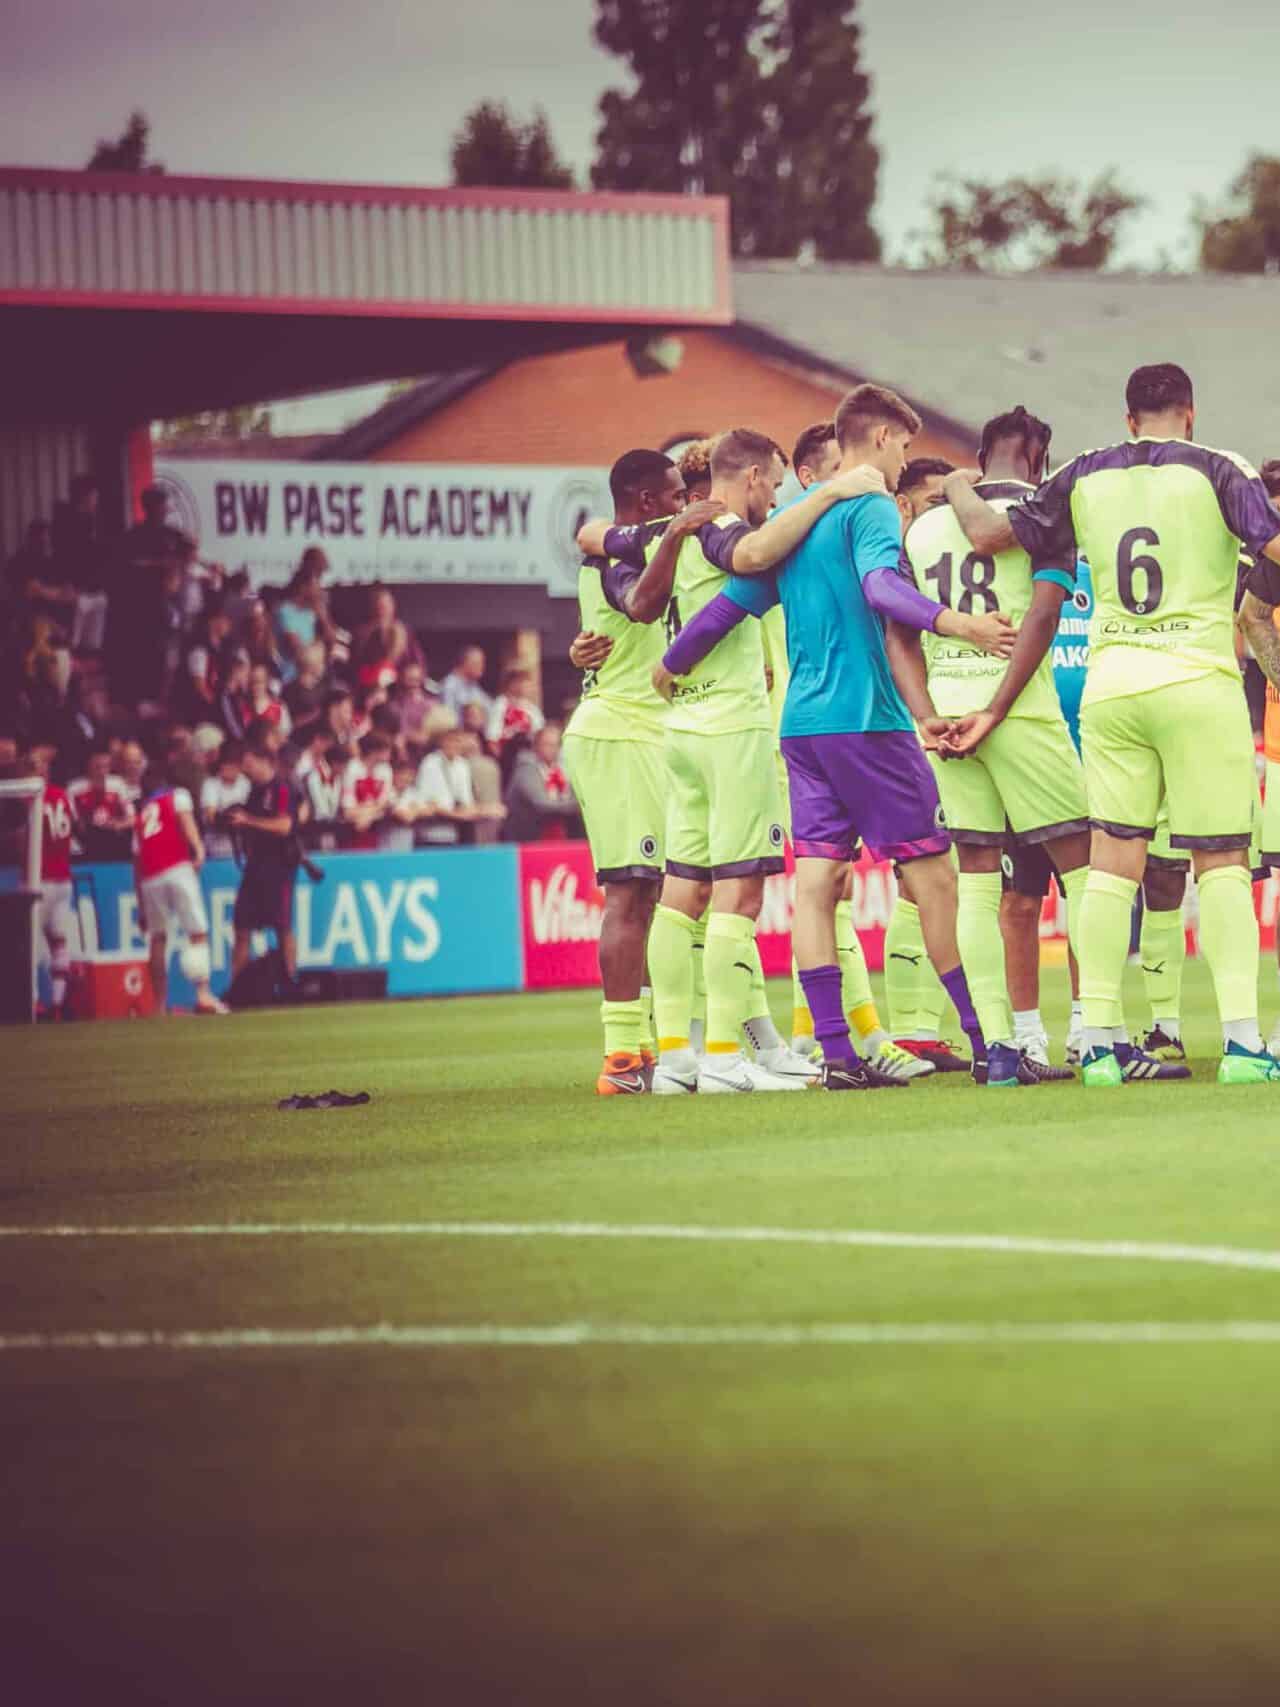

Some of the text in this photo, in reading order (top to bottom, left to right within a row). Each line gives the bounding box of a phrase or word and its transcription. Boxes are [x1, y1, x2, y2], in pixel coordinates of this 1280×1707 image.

[213, 481, 533, 540] BW PASE ACADEMY
[924, 551, 1000, 616] 18
[1116, 526, 1163, 615] 6
[1122, 621, 1190, 635] LEXUS
[946, 649, 989, 660] LEX
[43, 797, 71, 841] 16
[141, 801, 164, 840] 2
